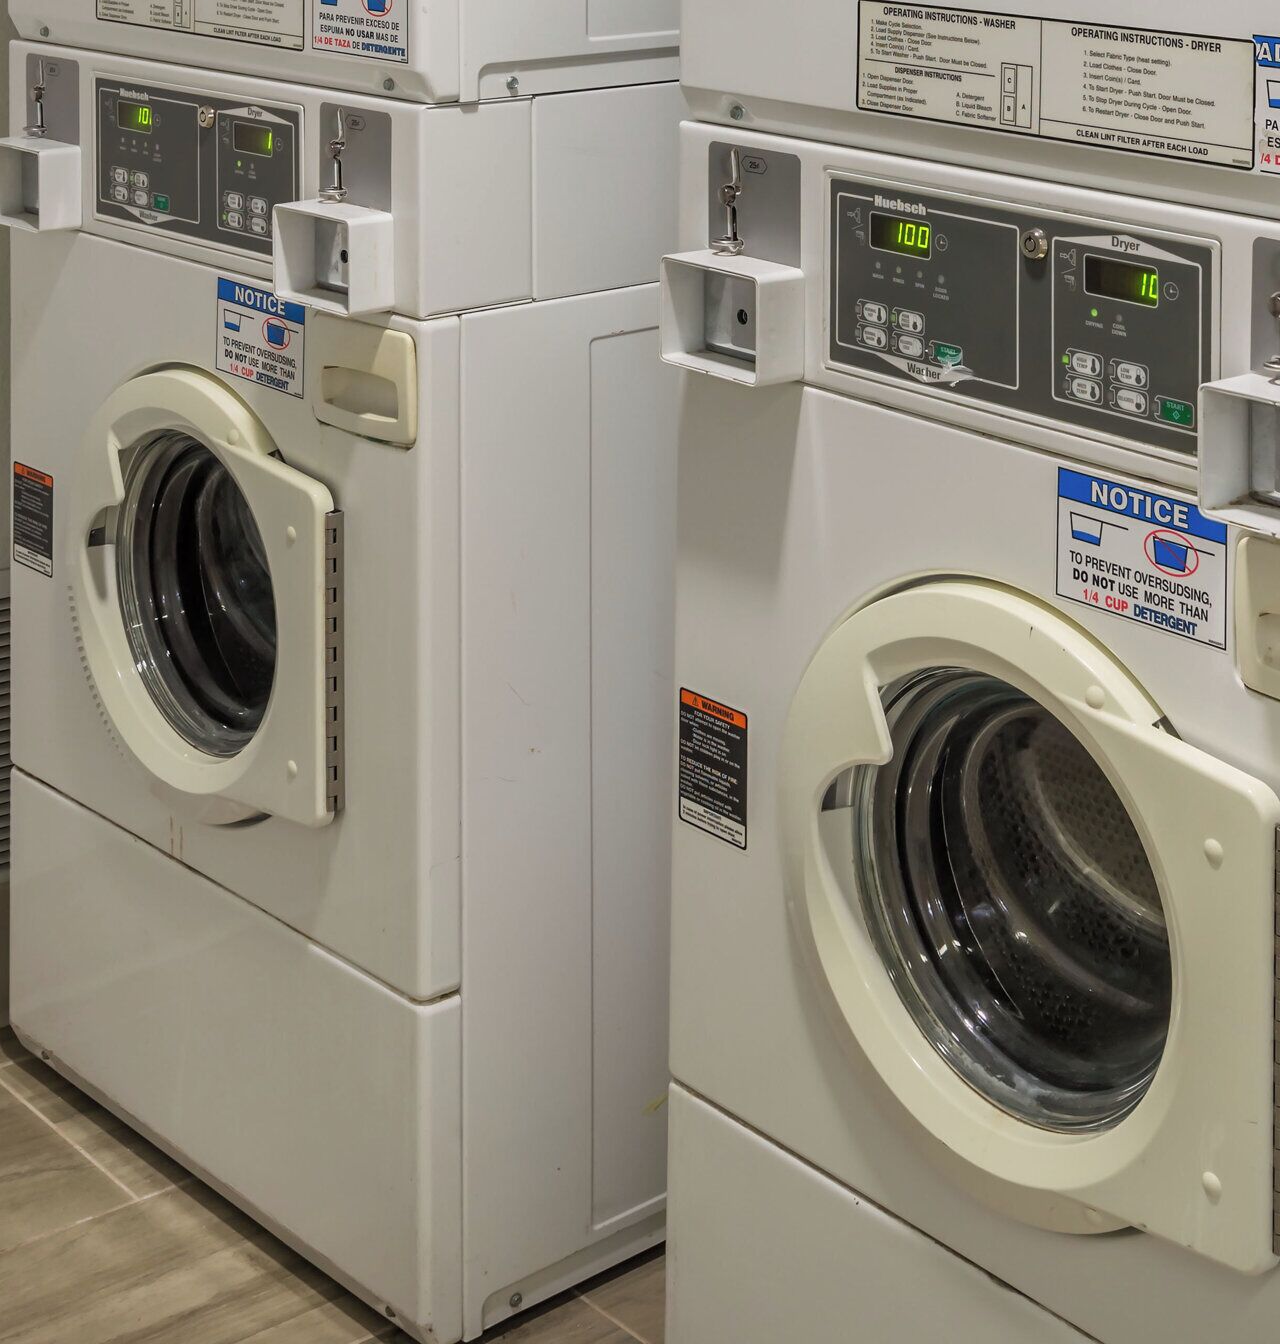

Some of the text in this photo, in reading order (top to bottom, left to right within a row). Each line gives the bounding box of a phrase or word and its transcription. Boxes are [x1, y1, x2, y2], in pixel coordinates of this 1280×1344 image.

[319, 12, 399, 31] PARA PREVENIR EXCESO DE
[883, 6, 923, 20] OPERATING
[924, 11, 978, 26] INSTRUCTIONS
[983, 17, 1016, 30] WASHER
[320, 25, 398, 43] ESPUMA NO USAR MAS DE
[1071, 26, 1119, 42] OPERATING
[1120, 31, 1184, 49] INSTRUCTIONS
[1191, 39, 1222, 53] DRYER
[314, 36, 405, 57] 1/4 DE TAZA DE DETERGENTE
[895, 66, 962, 82] DISPENSER INSTRUCTIONS
[247, 107, 263, 119] Dryer
[1076, 129, 1208, 156] CLEAN LINT FILTER AFTER EACH LOAD
[874, 194, 927, 216] Huebsch
[897, 222, 930, 249] 100
[1111, 235, 1140, 252] Dryer
[235, 285, 286, 315] NOTICE
[223, 336, 231, 346] TO
[231, 338, 256, 355] PREVENT
[225, 349, 295, 380] DO NOT USE MORE THAN
[907, 362, 942, 380] Washer
[230, 363, 289, 391] 1/4 CUP DETERGENT
[1166, 402, 1184, 411] START
[1091, 481, 1189, 529] NOTICE
[1069, 550, 1212, 608] TO PREVENT OVERSUDSING,
[1073, 568, 1209, 622] DO NOT USE MORE THAN
[1083, 588, 1197, 636] 1/4 CUP DETERGENT
[694, 710, 729, 730] FOR YOUR SAFETY
[701, 700, 734, 722] WARNING
